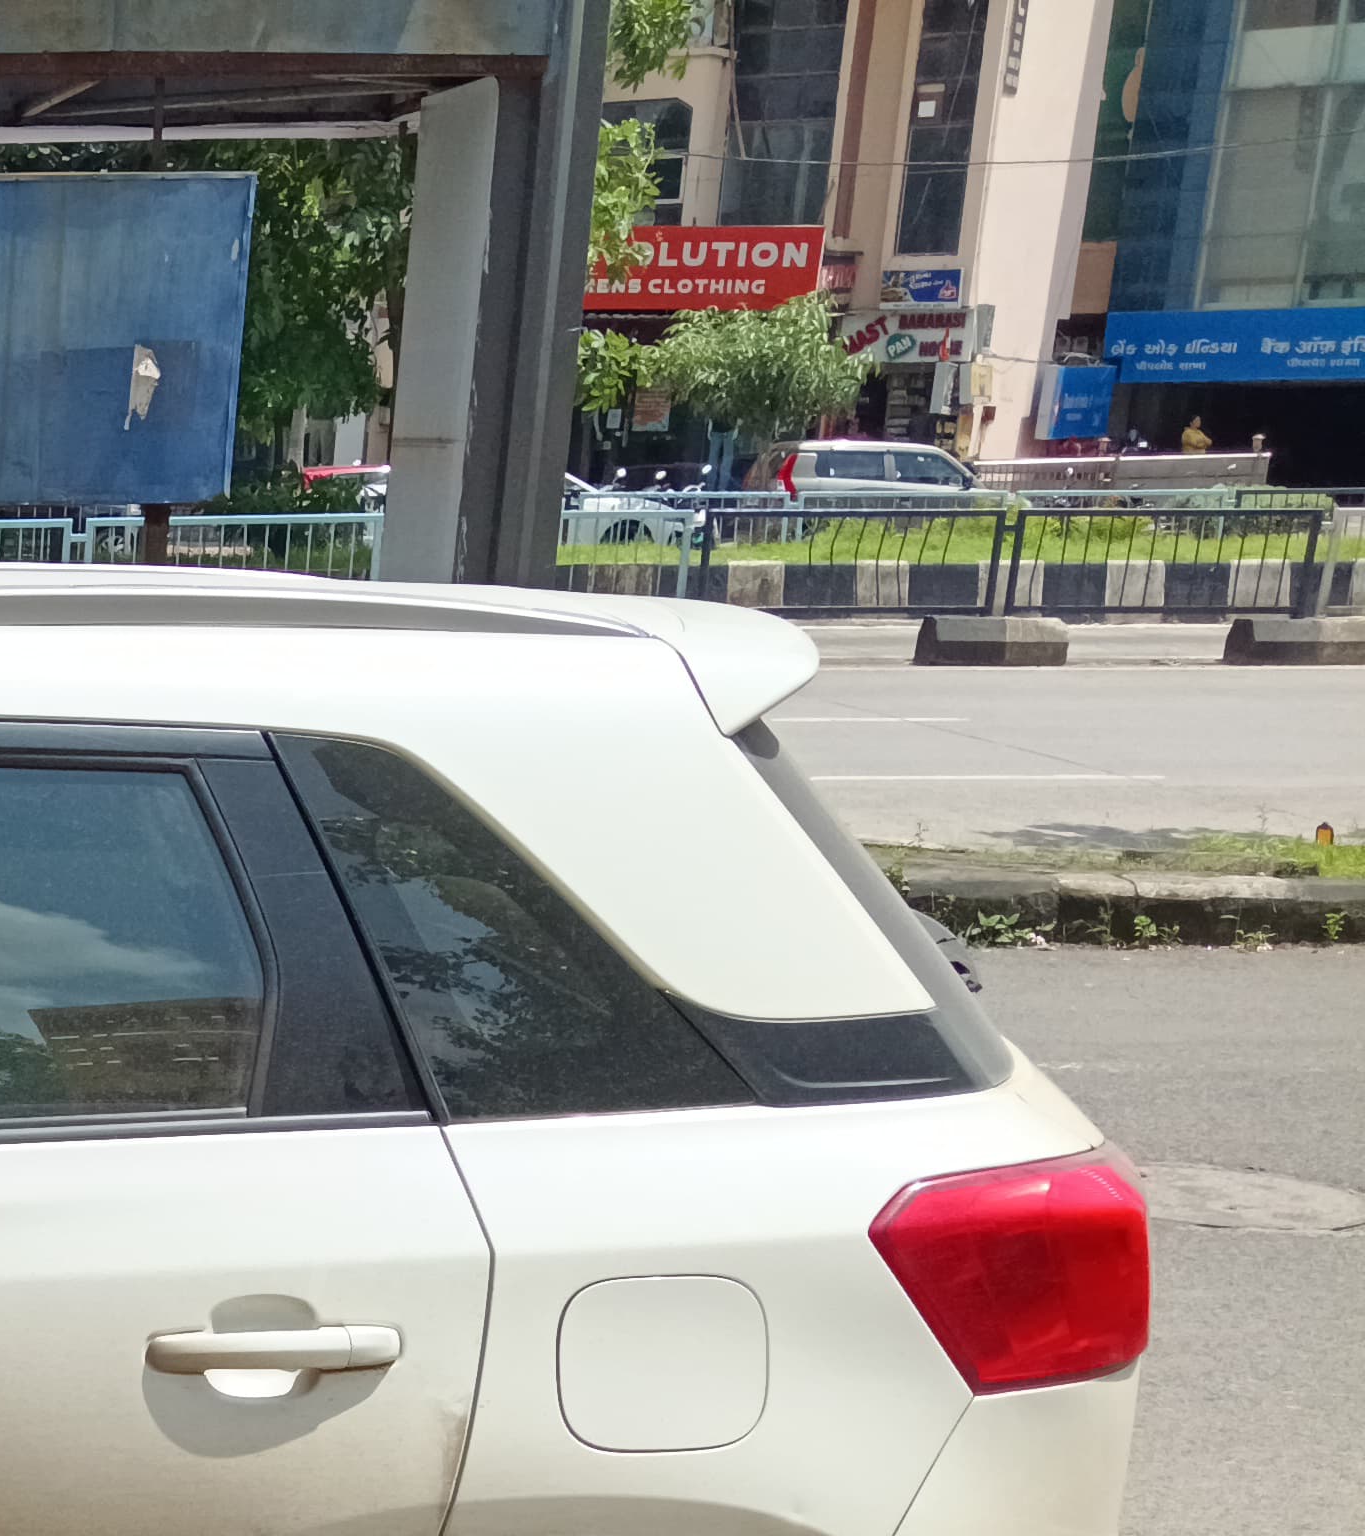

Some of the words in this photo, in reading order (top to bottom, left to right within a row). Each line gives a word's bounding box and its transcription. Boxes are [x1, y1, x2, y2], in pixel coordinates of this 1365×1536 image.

[619, 241, 809, 268] OLUTION
[648, 279, 765, 294] CLOTHING
[887, 336, 912, 357] PAN
